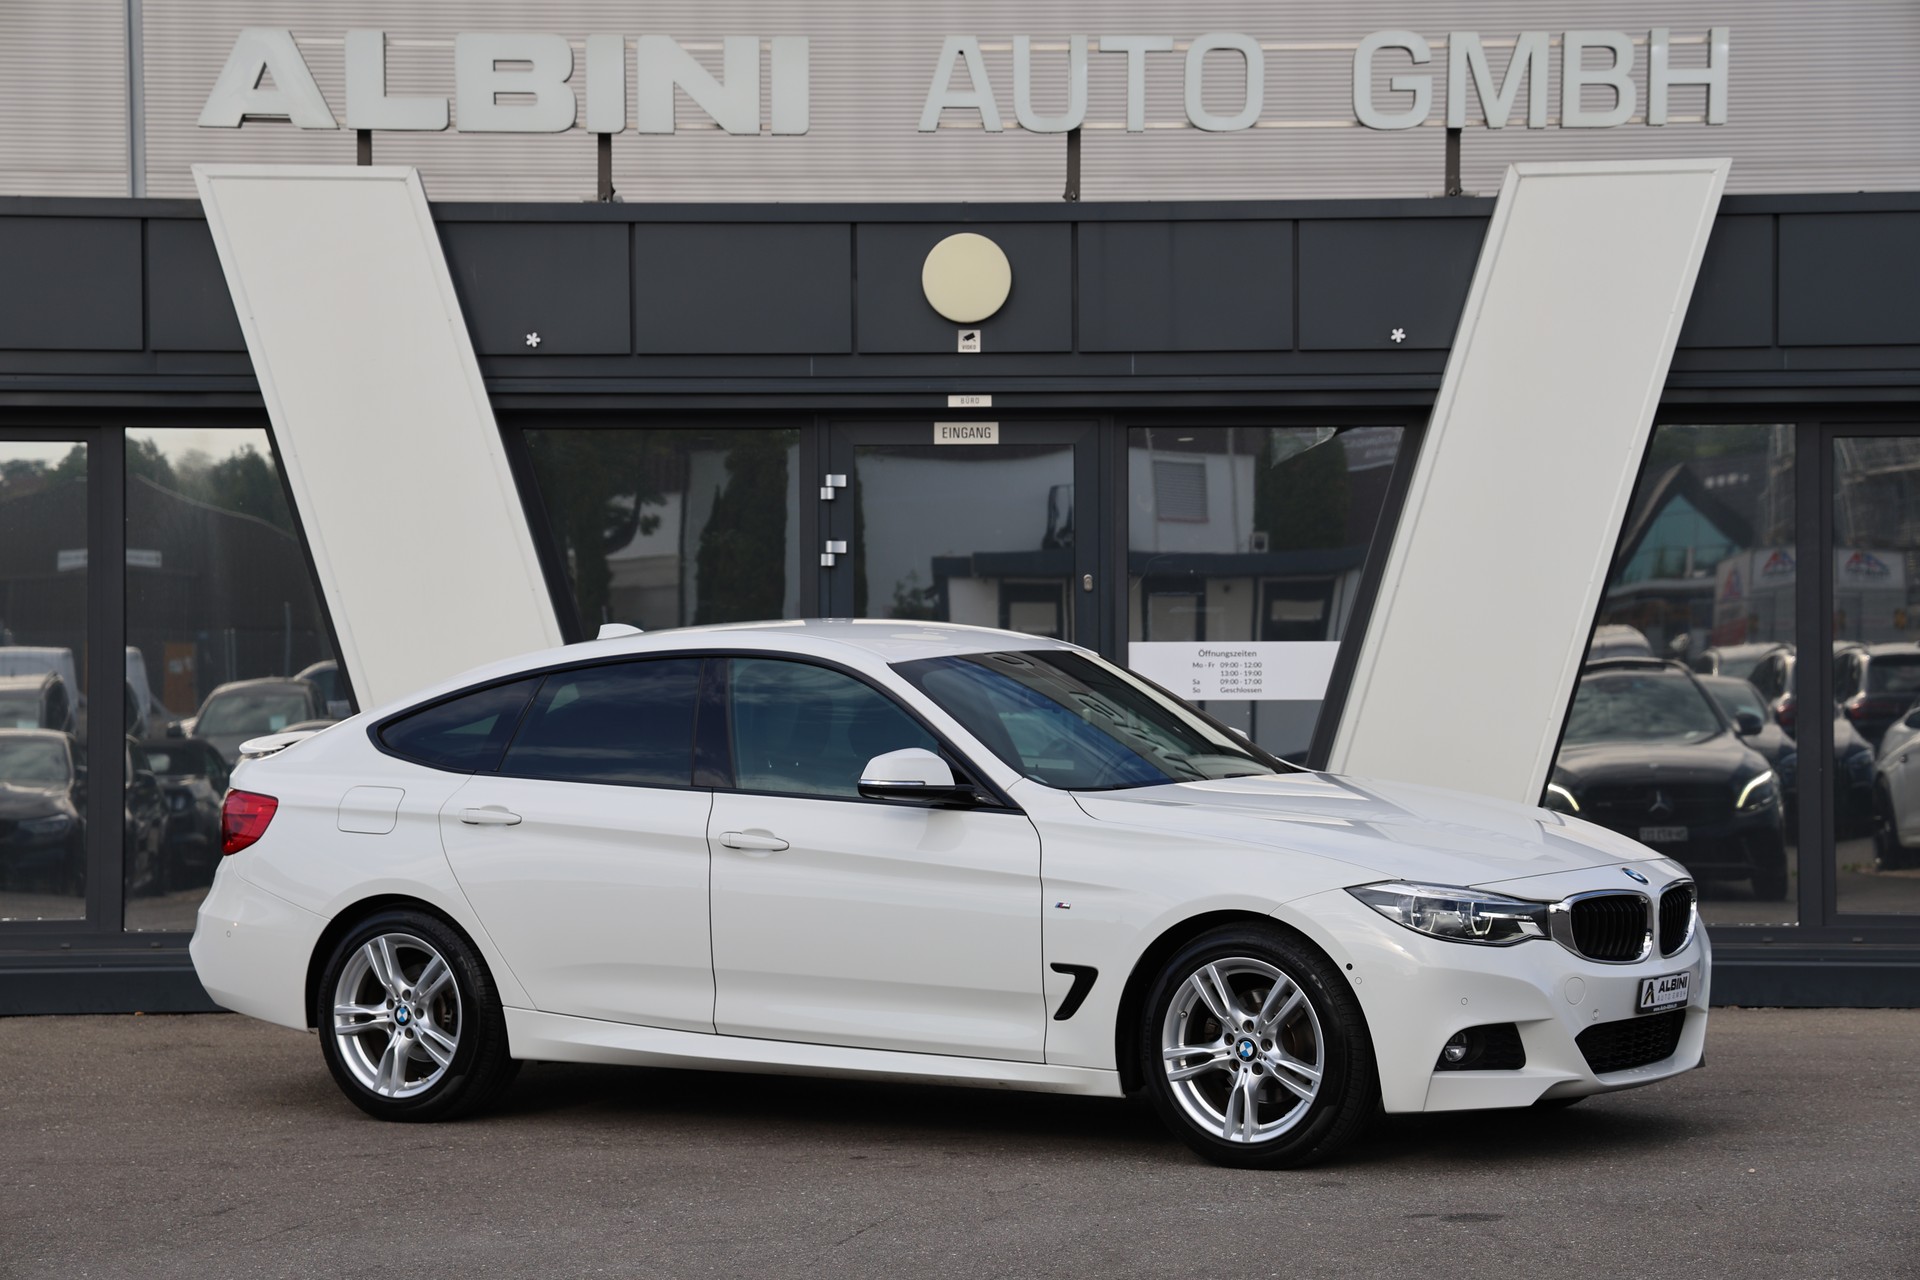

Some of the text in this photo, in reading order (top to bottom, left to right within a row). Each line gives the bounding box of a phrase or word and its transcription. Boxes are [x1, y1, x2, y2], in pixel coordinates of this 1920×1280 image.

[197, 27, 1731, 136] ALBINI AUTO GMBH
[960, 396, 980, 405] BÜRO
[941, 426, 992, 439] EINGANG
[1198, 649, 1258, 658] Öffnungszeiten
[1192, 661, 1204, 669] Mo
[1208, 661, 1215, 669] Fr
[1219, 661, 1239, 669] 09:00
[1244, 661, 1263, 669] 12:00
[1220, 669, 1239, 677] 13:00
[1244, 669, 1263, 677] 19:00
[1192, 678, 1201, 686] Sa
[1219, 678, 1239, 686] 09:00
[1244, 678, 1263, 686] 17:00
[1192, 686, 1263, 694] So Geschlossen
[1658, 976, 1688, 994] ALBINI
